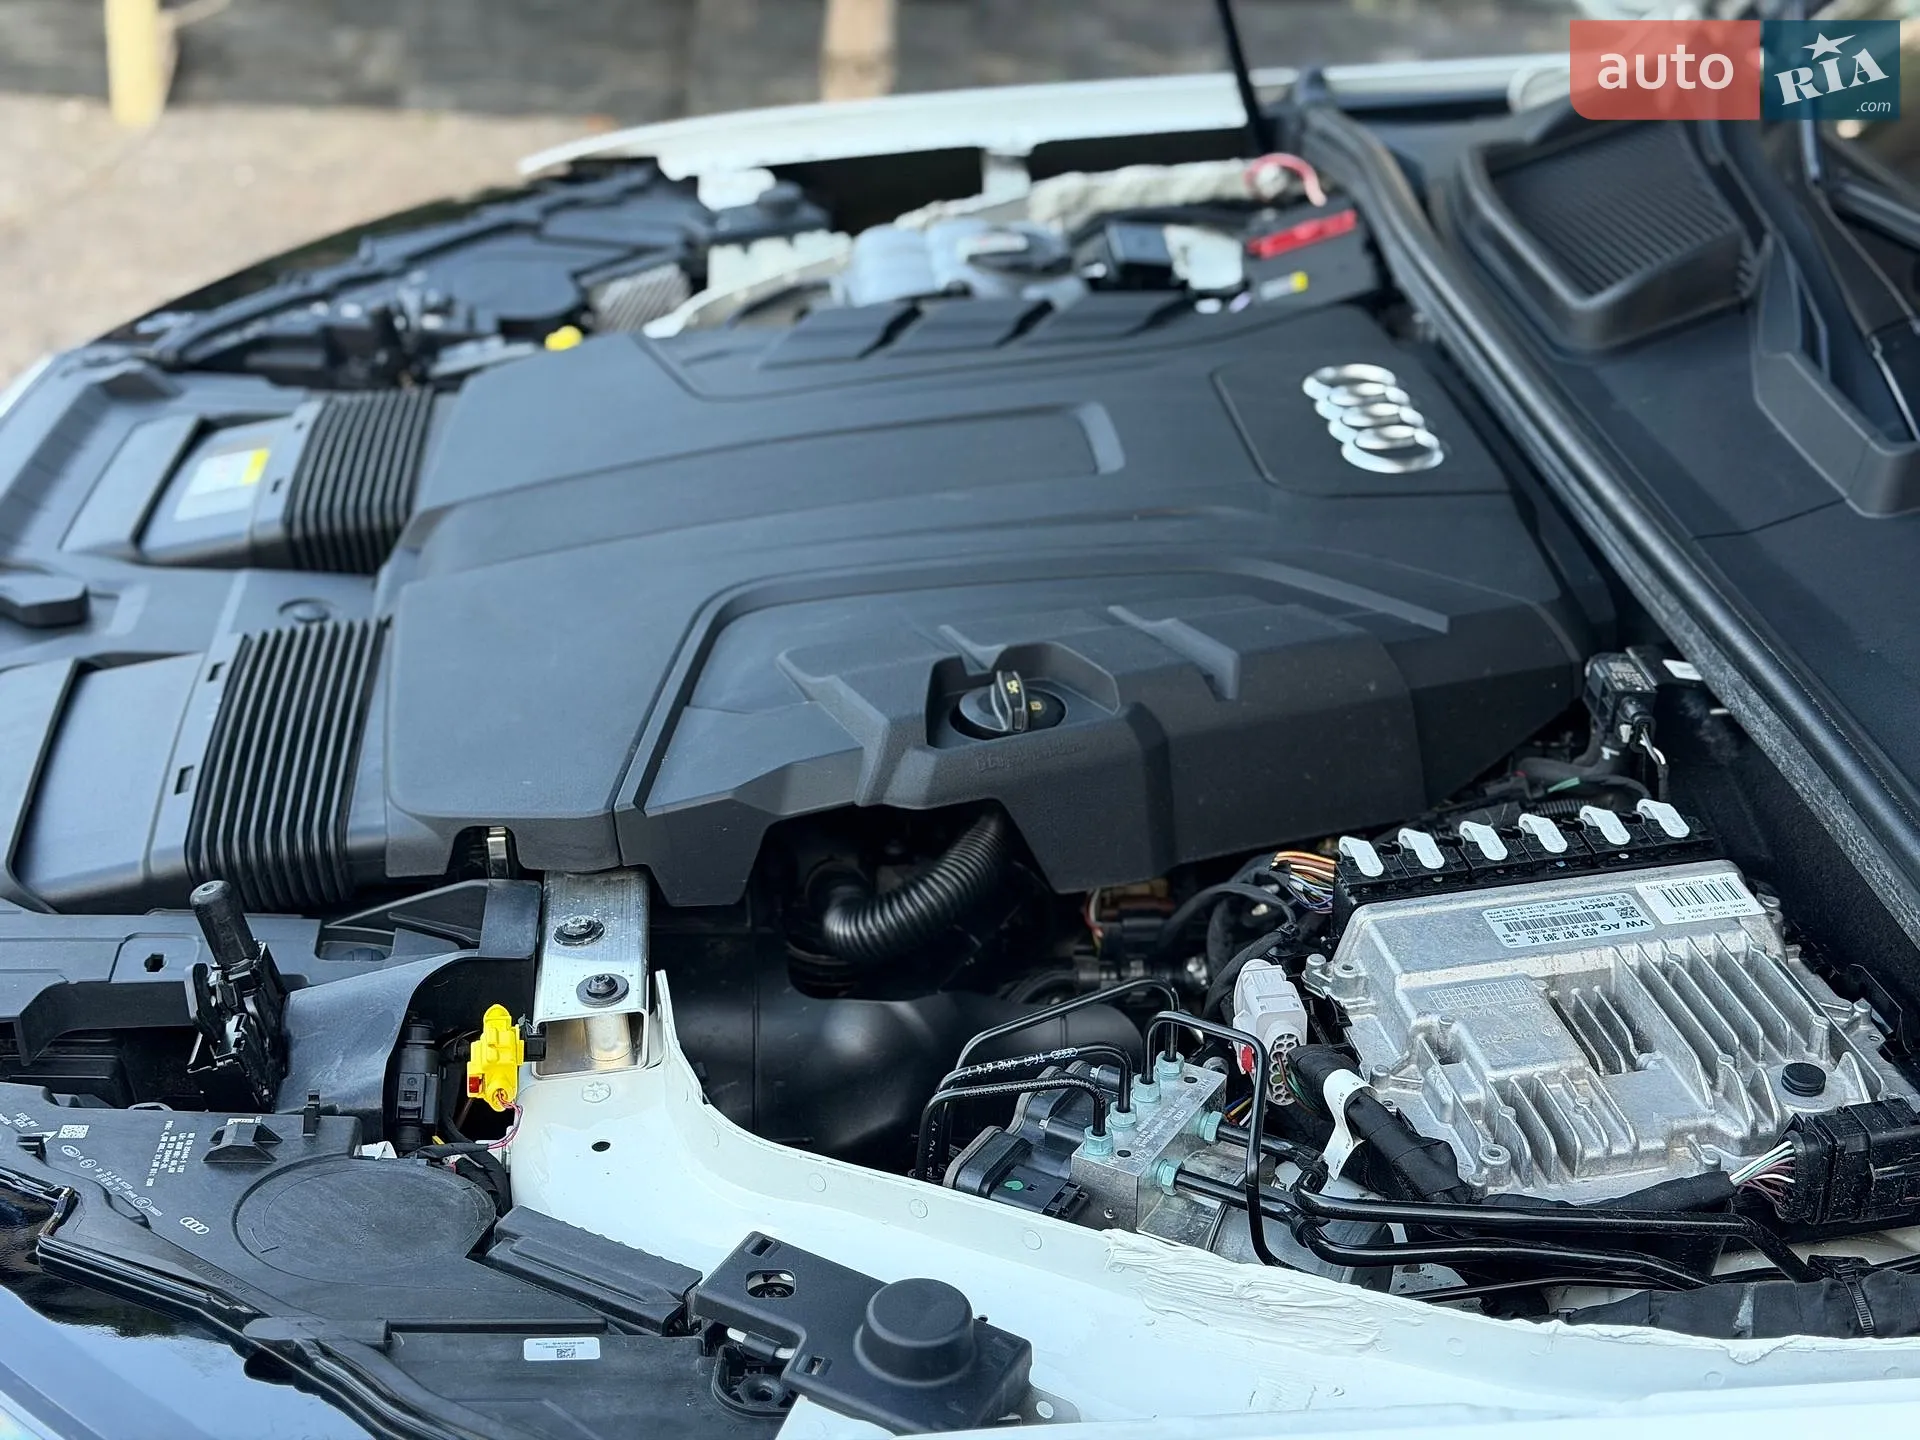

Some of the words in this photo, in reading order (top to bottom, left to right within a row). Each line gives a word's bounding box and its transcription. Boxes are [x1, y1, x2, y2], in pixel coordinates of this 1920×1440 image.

[1580, 901, 1615, 910] BOSCH
[1599, 922, 1622, 931] AG
[1623, 918, 1649, 928] VW
[1561, 930, 1579, 939] 907
[1580, 927, 1598, 936] 059
[1526, 934, 1540, 943] AC
[1541, 932, 1560, 941] 309
